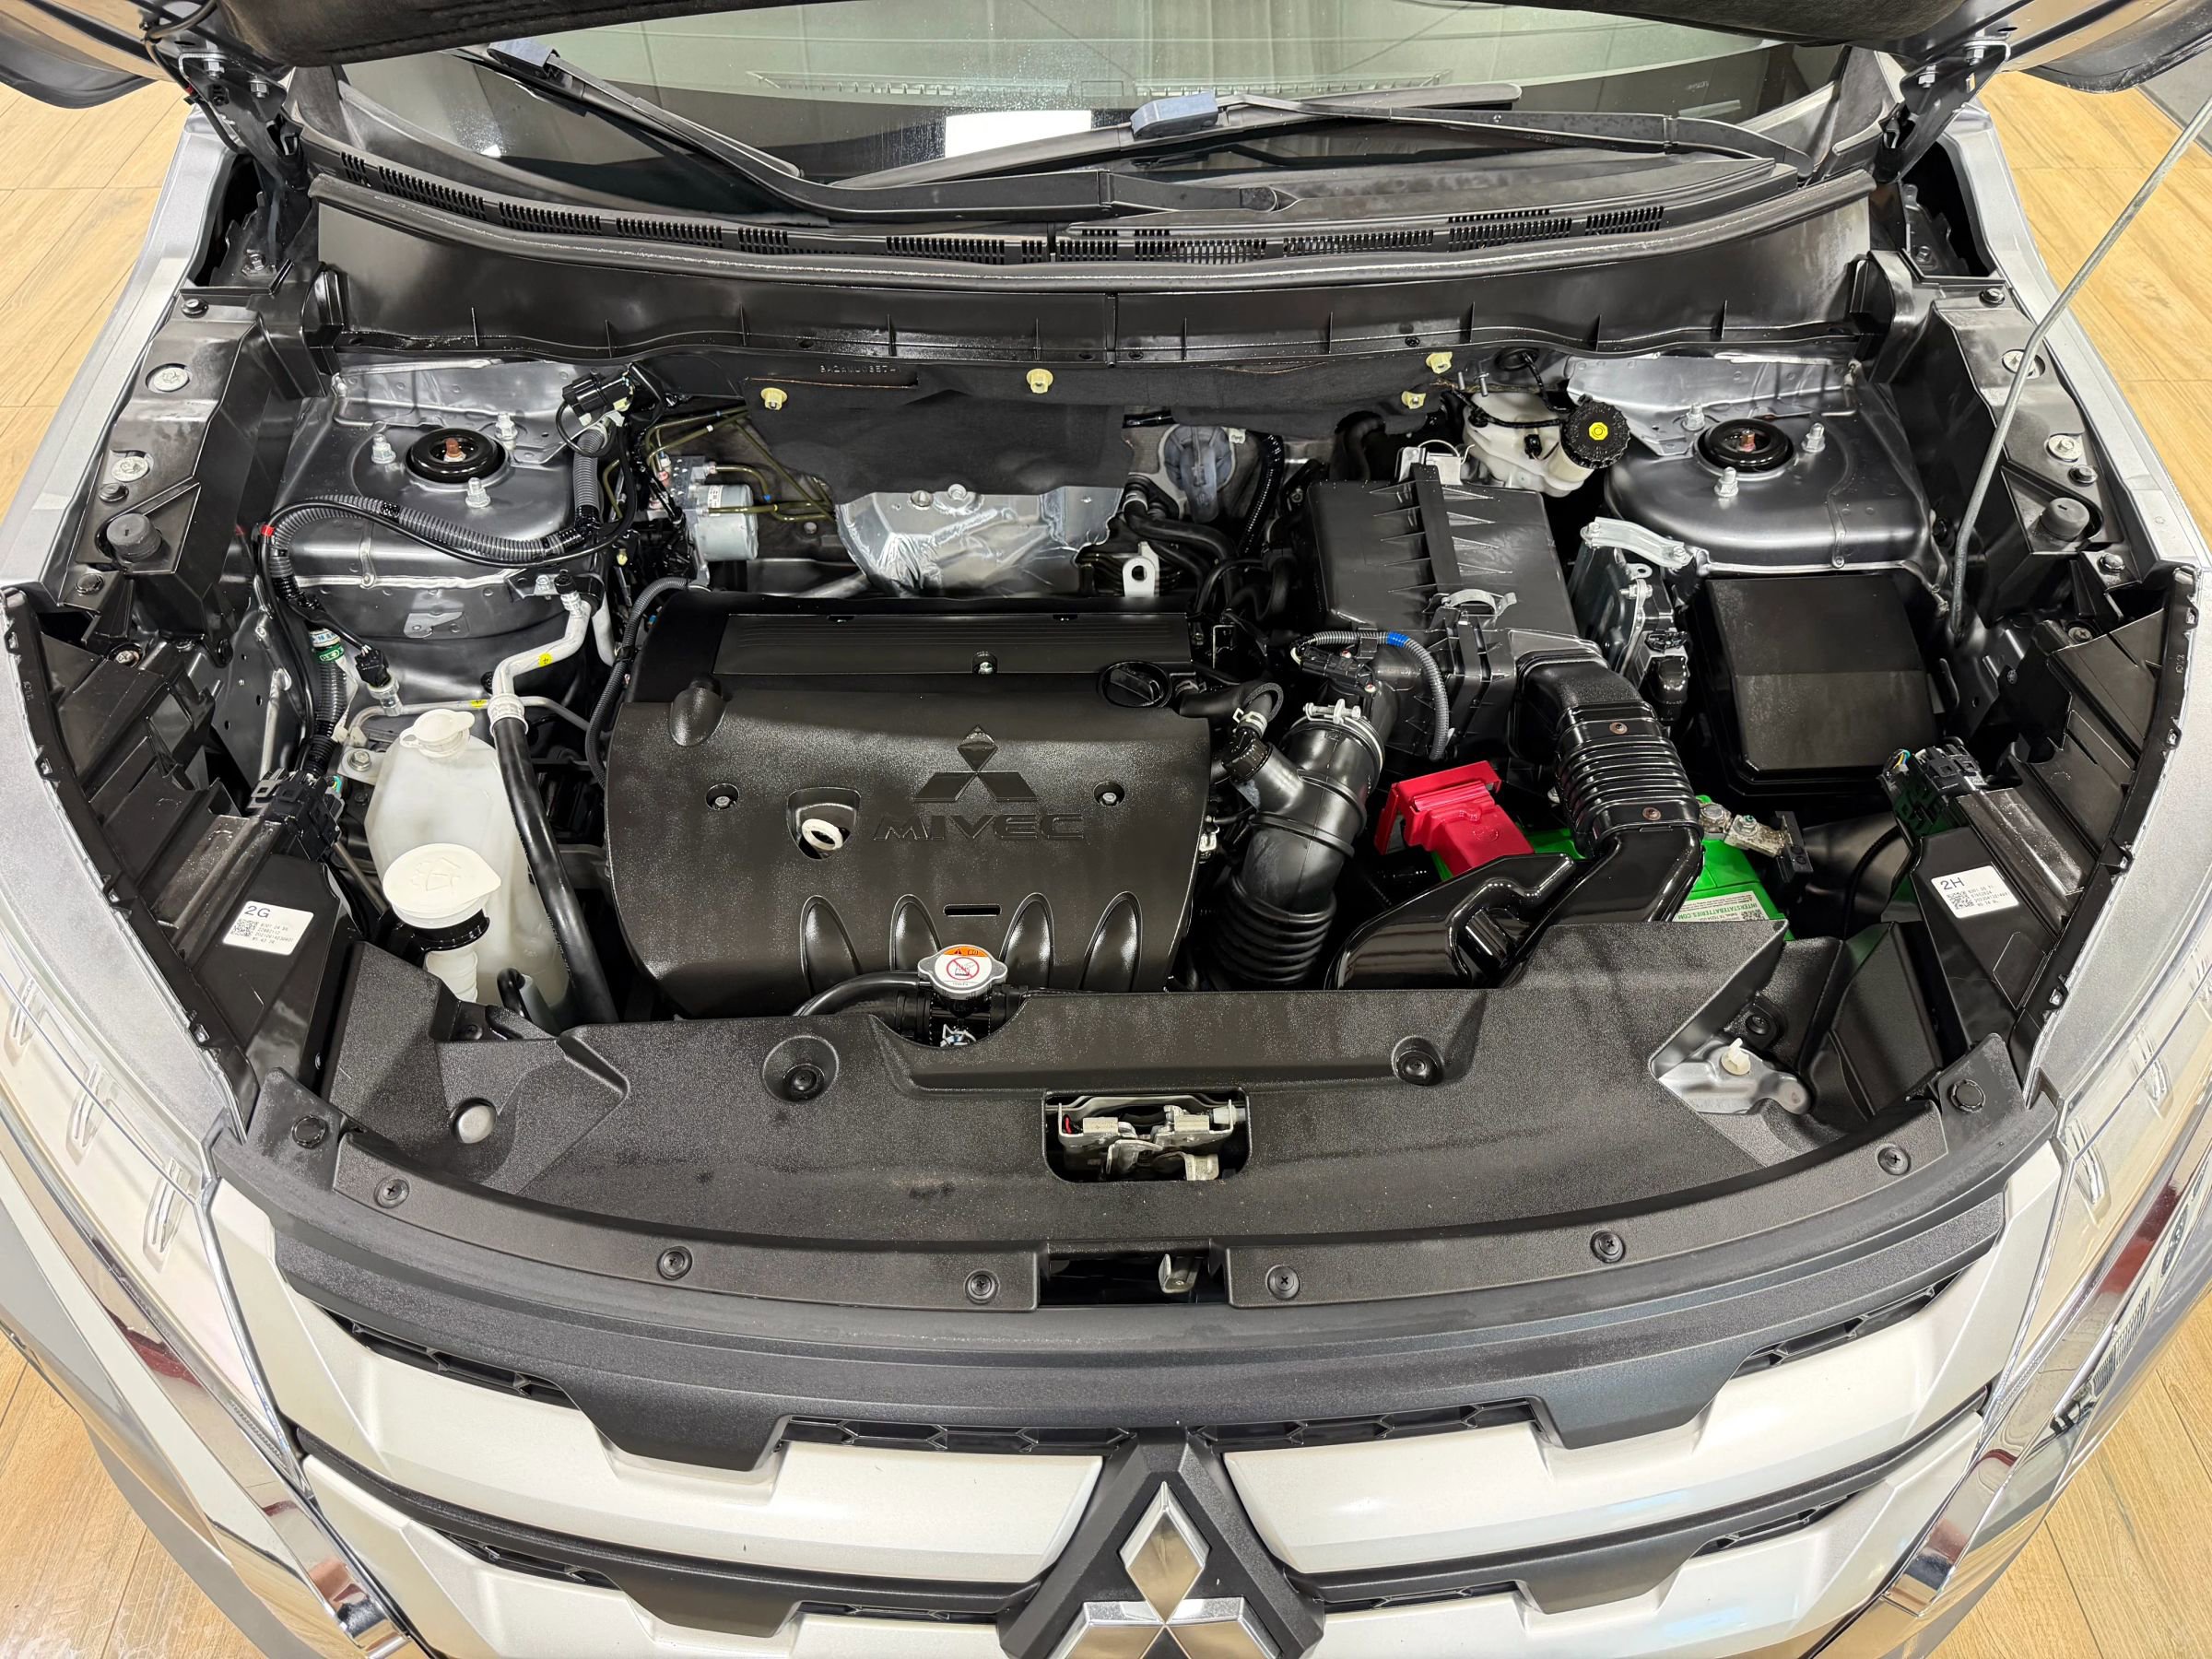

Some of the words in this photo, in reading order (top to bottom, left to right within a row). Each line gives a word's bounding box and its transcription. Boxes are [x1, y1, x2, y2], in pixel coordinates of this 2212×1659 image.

[873, 813, 1085, 841] MIVEC
[1940, 877, 1965, 890] 2H
[244, 905, 271, 919] 2G
[1677, 902, 1758, 920] INTERSTATEBATTERIES.COM
